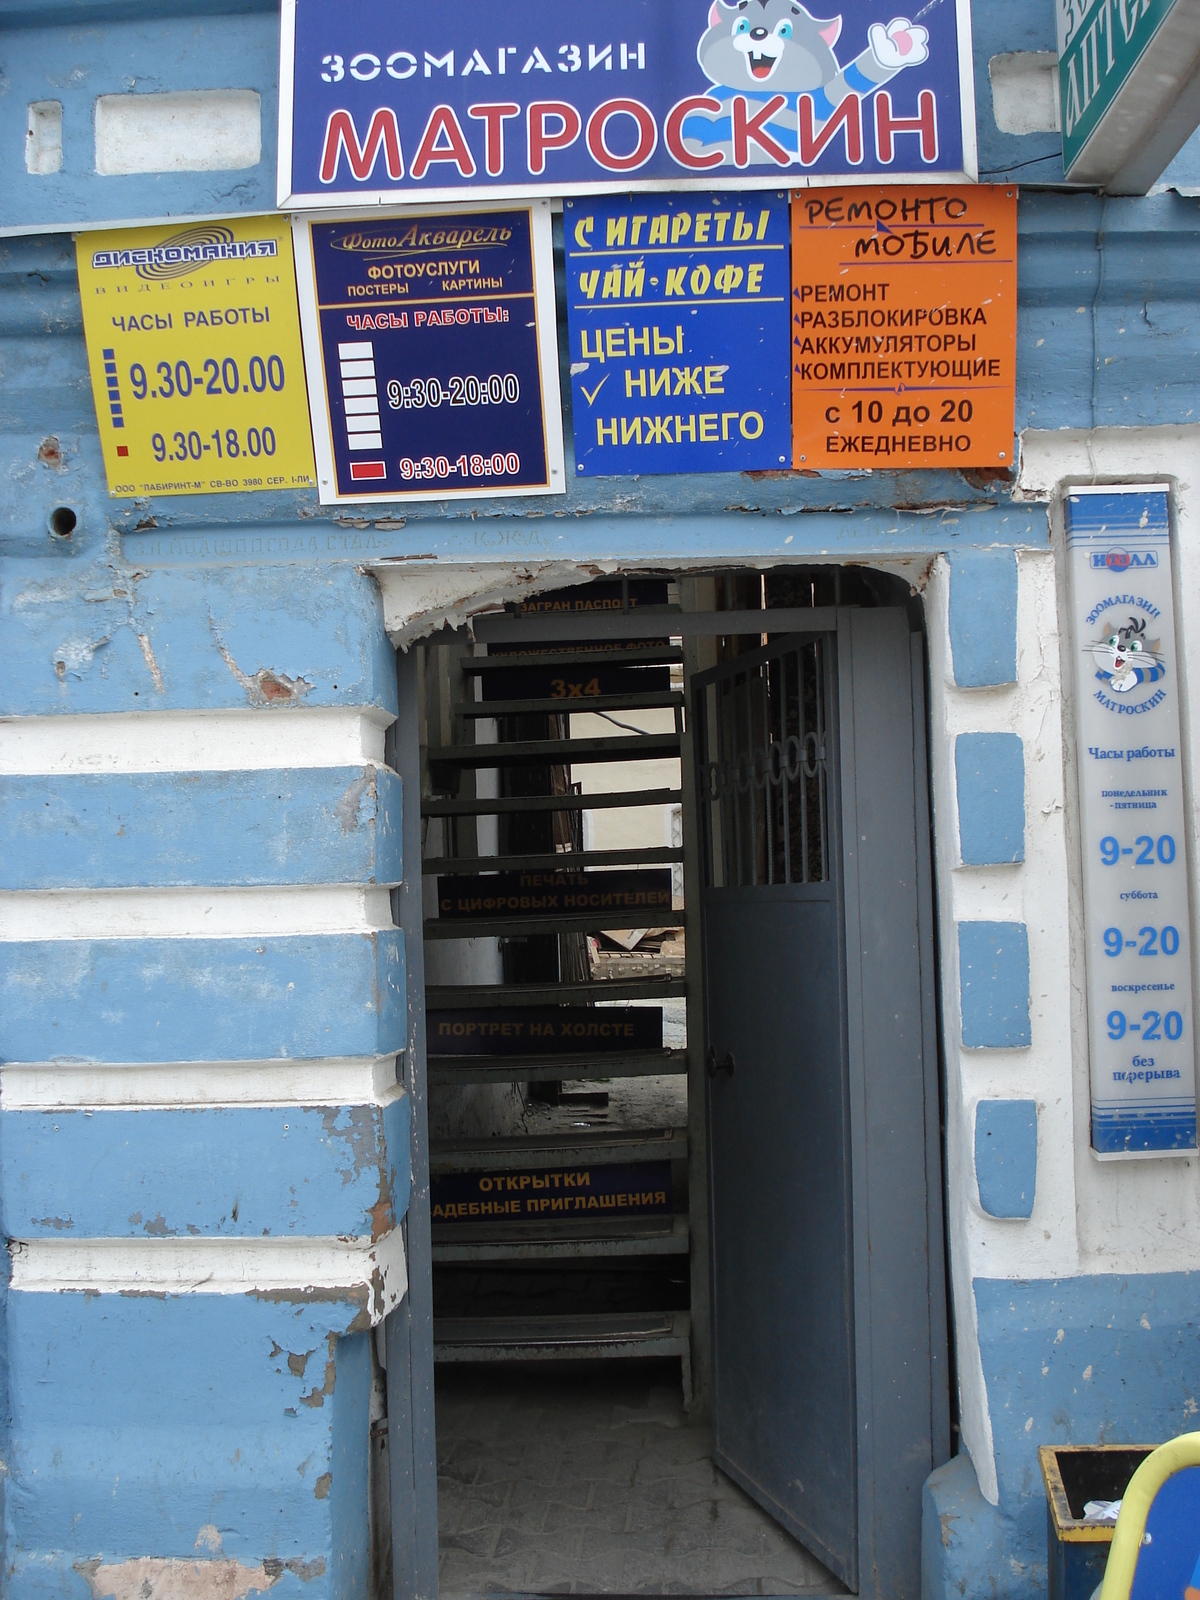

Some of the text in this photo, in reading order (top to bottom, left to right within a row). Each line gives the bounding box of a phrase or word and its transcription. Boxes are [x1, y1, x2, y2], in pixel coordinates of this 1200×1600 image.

[320, 42, 646, 83] ЗООМАГАЗИН
[318, 90, 940, 184] МАТРОСКИН
[92, 239, 278, 269] ДИСКОМАНИЯ
[854, 229, 997, 260] МОБИЛЕ
[367, 260, 480, 280] ФОТОУСЛУГИ
[579, 261, 764, 299] ЧАЙ КОФЕ
[95, 275, 281, 295] ВИДЕОИГРЫ
[347, 277, 503, 297] ПОСТЕРЫ КАРТИНЫ
[800, 283, 890, 303] РЕМОНТ
[112, 306, 270, 332] ЧАСЫ РАБОТЫ
[346, 306, 510, 331] ЧАСЫ РАБОТЫ:
[800, 307, 988, 329] РАЗБЛОКИРОВКА
[580, 325, 684, 363] ЦЕНЫ
[800, 333, 977, 355] АККУМУЛЯТОРЫ
[129, 354, 285, 400] 9.30-20.00
[624, 365, 725, 398] НИЖЕ
[801, 359, 1001, 381] КОМПЛЕКТУЮЩИЕ
[386, 373, 520, 410] 9:30-20:00
[852, 400, 883, 423] 10
[892, 405, 931, 427] до
[940, 399, 973, 422] 20
[596, 411, 764, 446] НИЖНЕГО
[151, 426, 276, 462] 9.30-18.00
[826, 435, 972, 455] ЕЖЕДНЕВНО
[399, 452, 520, 480] 9:30-18:00
[115, 484, 136, 493] ООО
[210, 479, 239, 489] СВ-ВО
[267, 476, 288, 485] СЕР.
[521, 598, 638, 612] ЗАГРАН ПАСПОТ
[1086, 594, 1161, 626] ЗООМАГАЗИН
[1093, 688, 1167, 715] МАТРОСКИН
[1088, 745, 1175, 761] Часы работы
[1101, 788, 1168, 798] понедельник
[1100, 834, 1176, 866] 9-20
[520, 874, 589, 887] ПЕЧАТЬ
[458, 896, 558, 913] ЦИФРОВЫХ
[564, 890, 670, 908] НОСИТЕЛЕЙ
[1119, 891, 1159, 901] суббота
[1103, 925, 1180, 957] 9-20
[1111, 982, 1175, 994] воскресенье
[439, 1023, 635, 1036] ПОРТРЕТ НА ХОЛСТЕ
[1107, 1010, 1183, 1041] 9-20
[1132, 1055, 1155, 1067] без
[1113, 1069, 1181, 1083] перерыва
[479, 1172, 591, 1192] ОТКРЫТКИ
[431, 1191, 667, 1219] АДЕБНЫЕ ПРИГЛАШЕНИЯ
